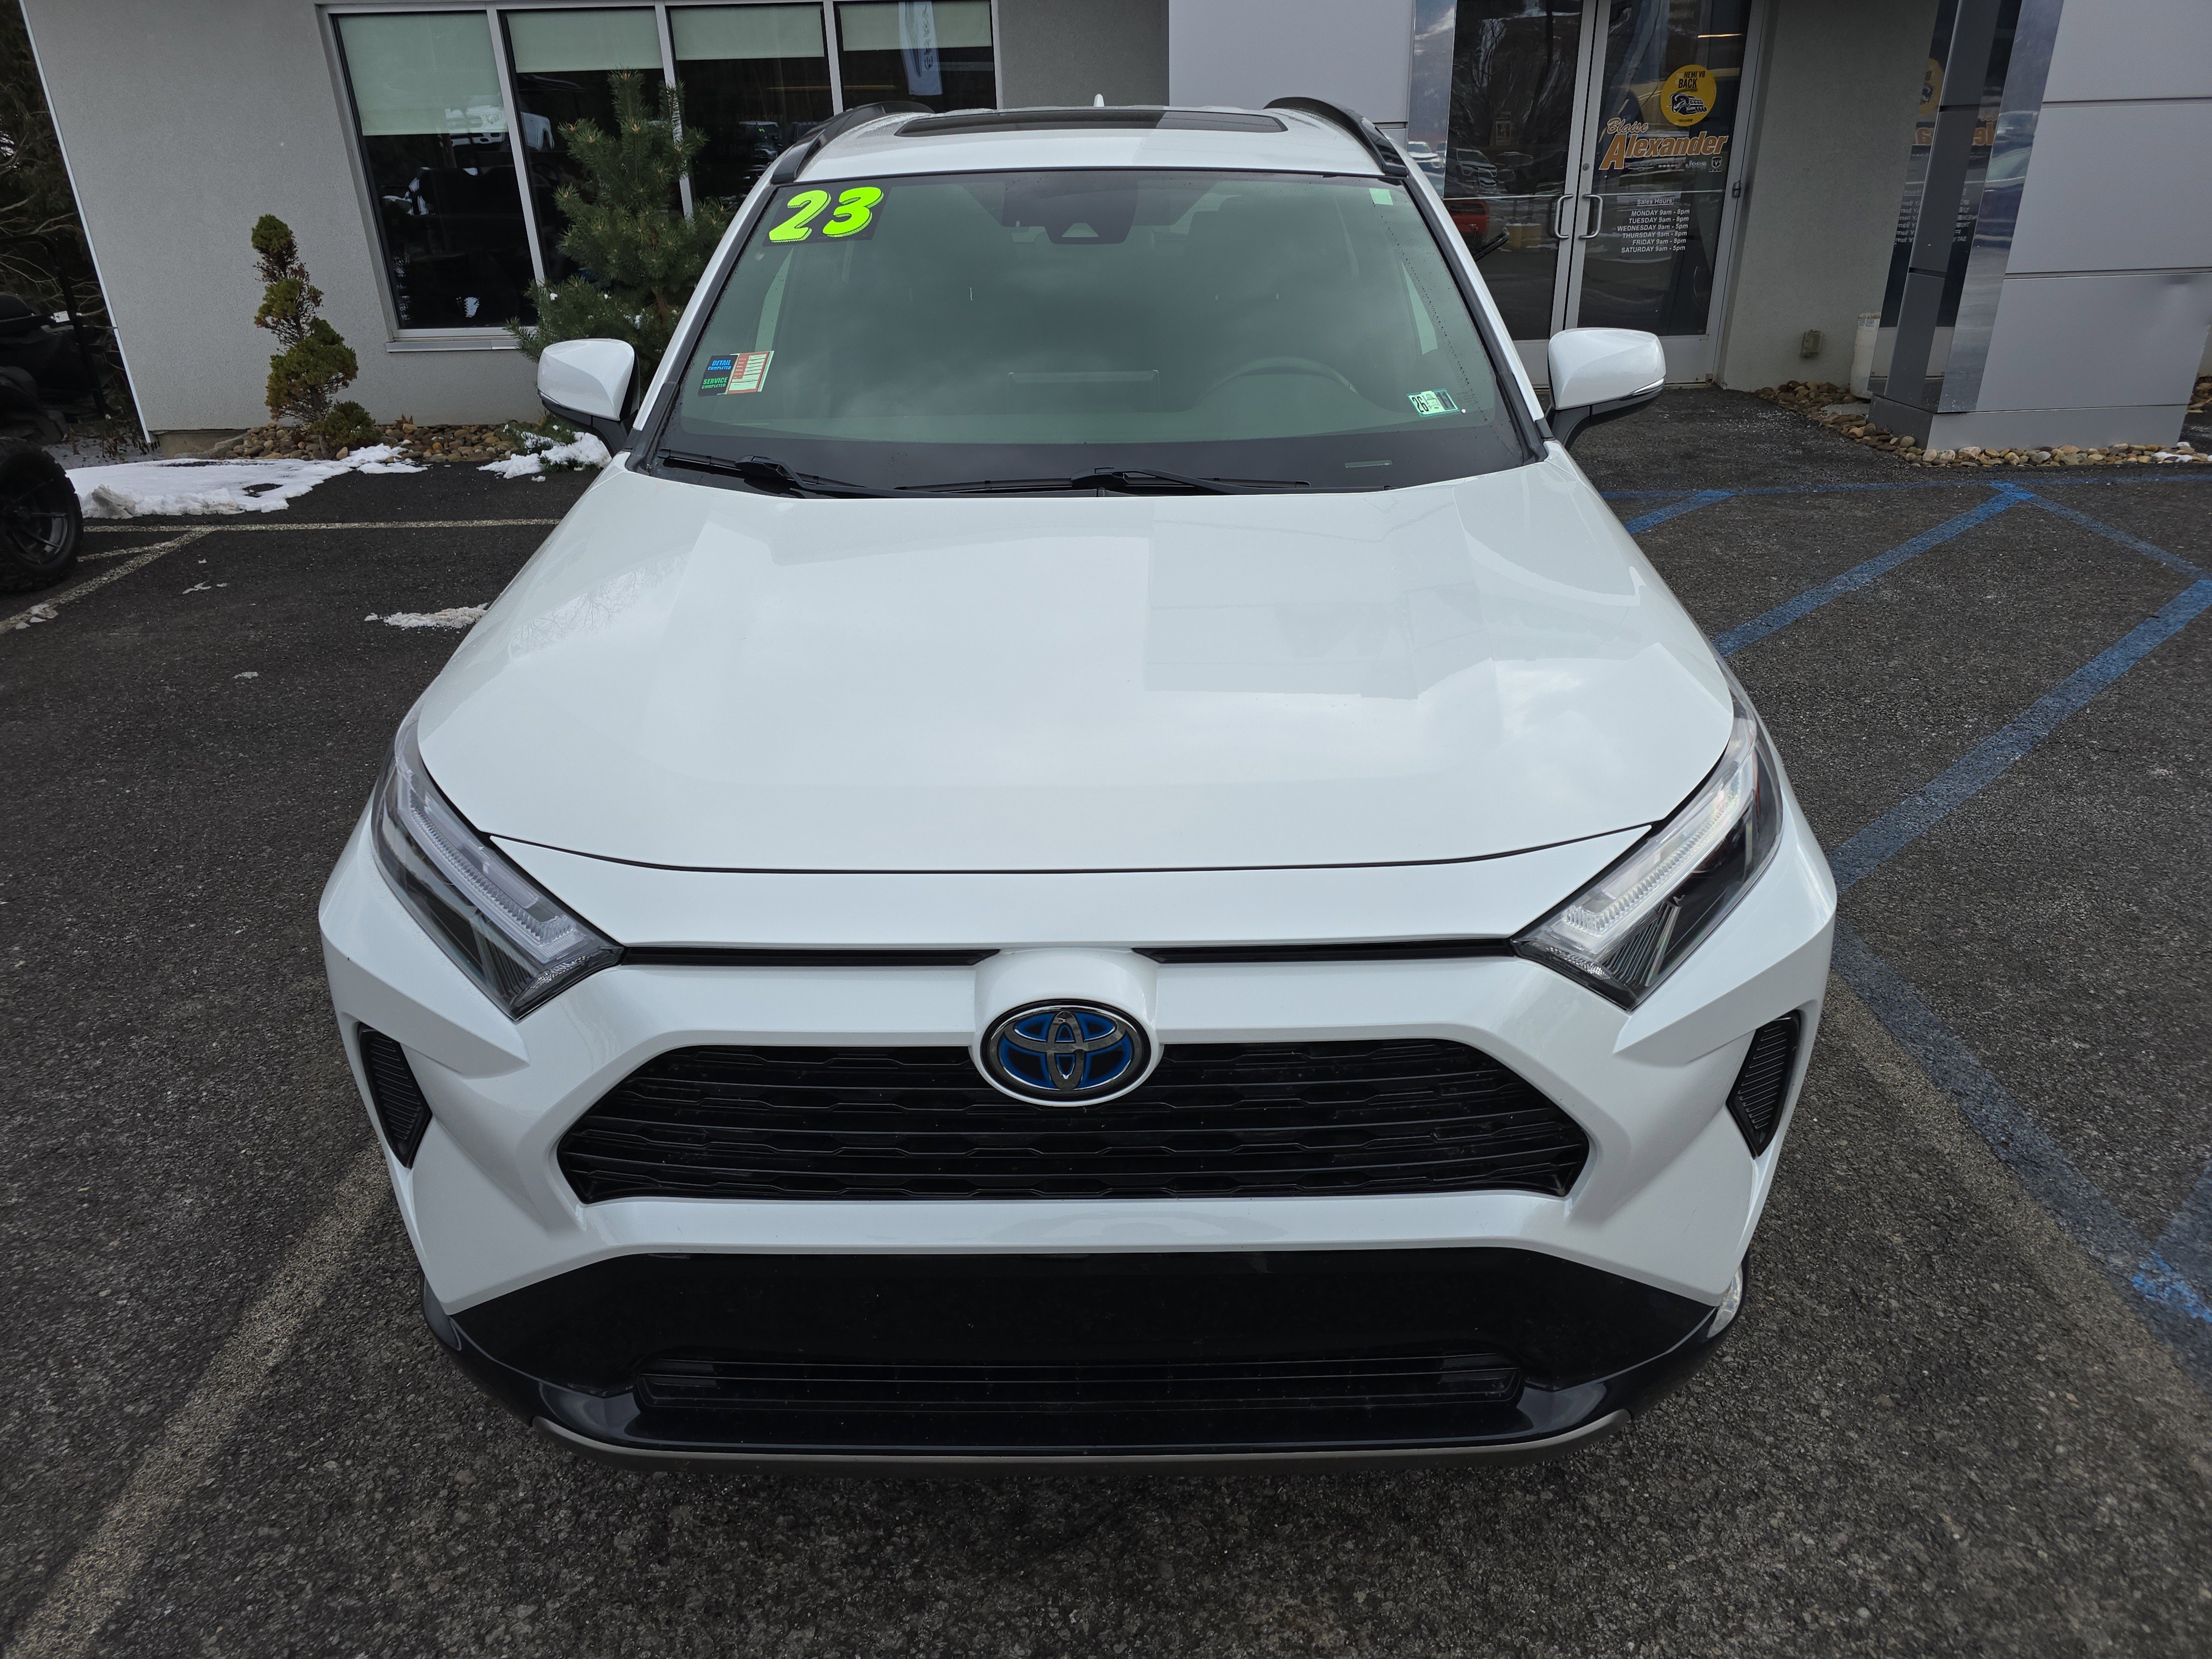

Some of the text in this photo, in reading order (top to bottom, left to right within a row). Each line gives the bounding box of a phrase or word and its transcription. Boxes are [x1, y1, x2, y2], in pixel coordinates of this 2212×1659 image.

[1678, 79, 1698, 88] BACK
[1607, 118, 1649, 134] Blaise
[1598, 131, 1729, 170] Alexander
[769, 187, 884, 243] 23
[703, 377, 728, 385] SERVICE
[1412, 396, 1429, 413] 26
